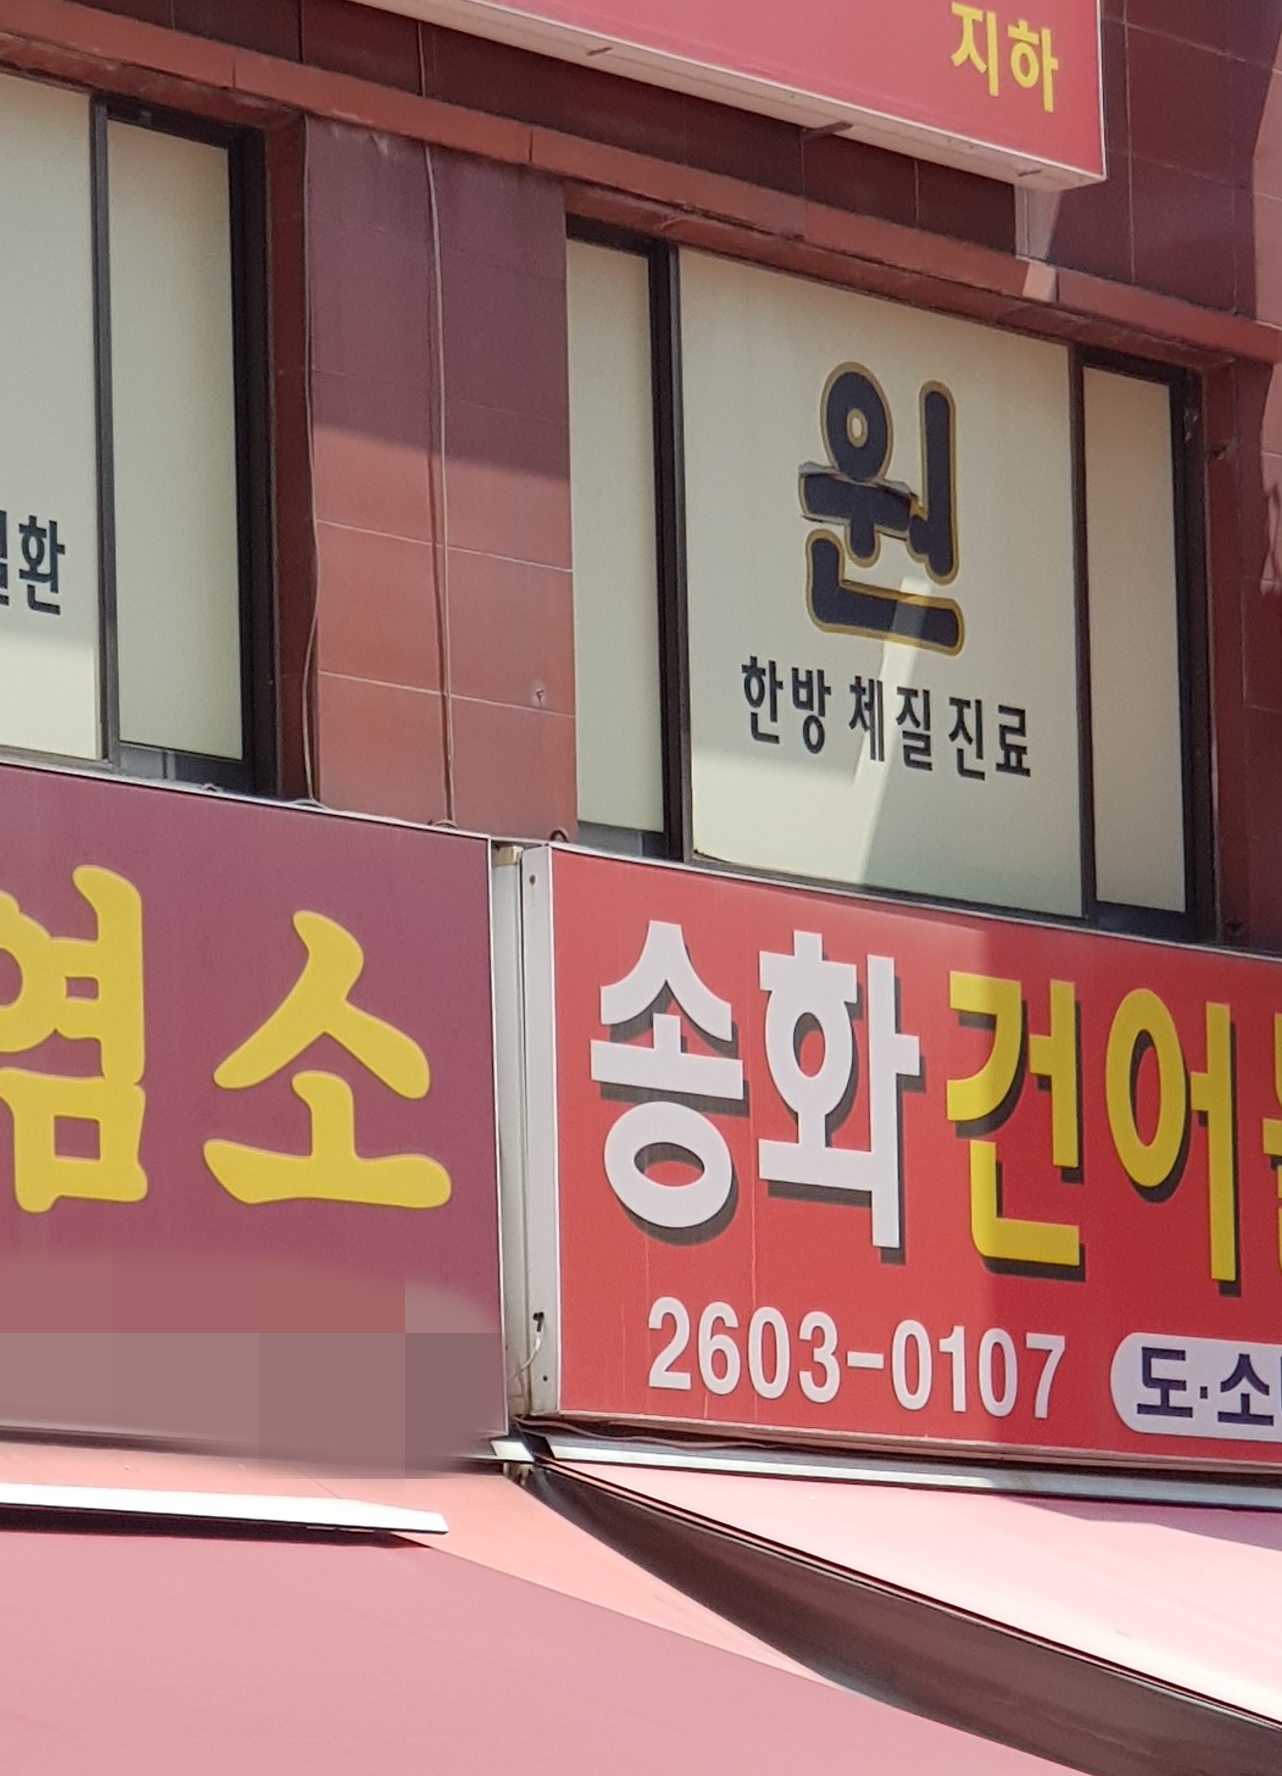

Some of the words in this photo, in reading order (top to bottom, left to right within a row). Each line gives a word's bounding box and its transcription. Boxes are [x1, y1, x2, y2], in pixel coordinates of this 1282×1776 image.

[950, 2, 1059, 112] 지하
[798, 361, 965, 656] 원
[741, 656, 832, 755] 한방
[848, 676, 933, 772] 체질
[947, 696, 1031, 781] 진료
[945, 970, 1282, 1285] 건어
[647, 1296, 1066, 1421] 2603-0107
[1136, 1346, 1282, 1427] 도·소
